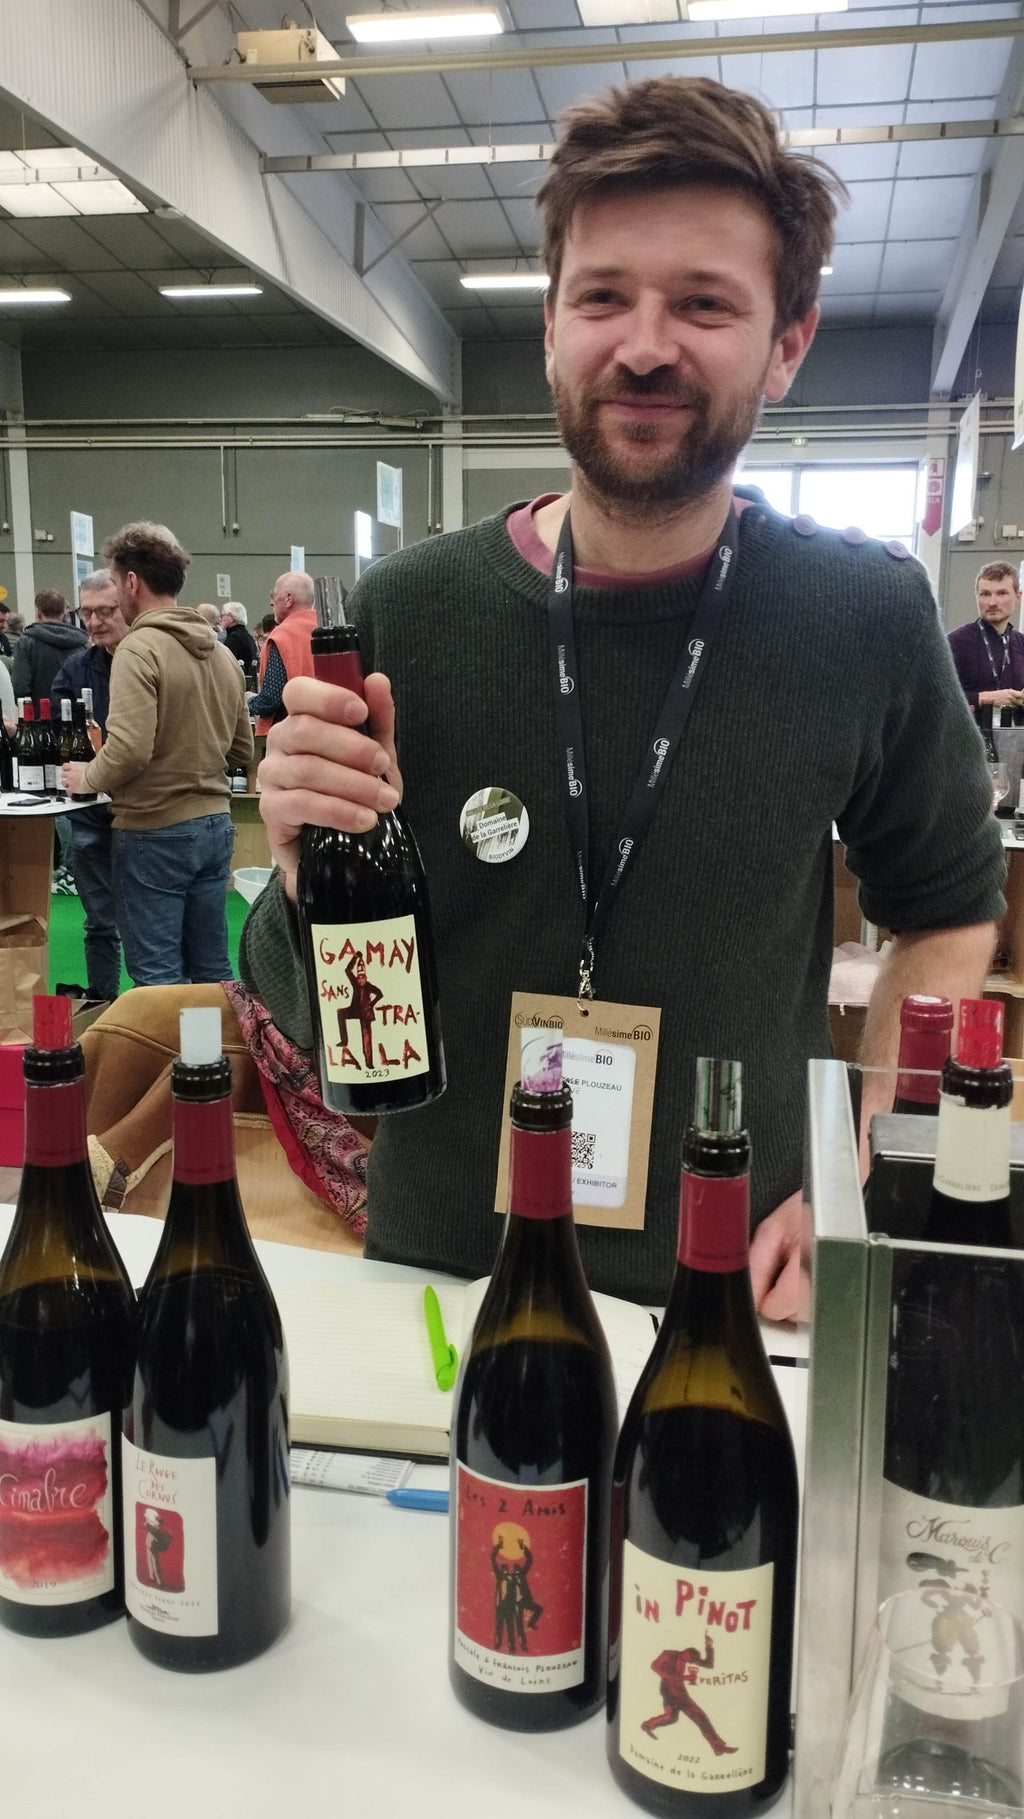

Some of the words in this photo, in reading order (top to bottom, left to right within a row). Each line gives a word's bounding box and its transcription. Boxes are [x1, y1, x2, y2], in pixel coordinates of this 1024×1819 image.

[479, 815, 506, 829] Domaine
[472, 833, 480, 841] de
[319, 936, 415, 974] GAMAY
[320, 979, 350, 1002] SANS
[327, 1045, 362, 1071] LA
[378, 1038, 421, 1070] LA
[364, 1068, 390, 1078] 2023
[581, 1079, 623, 1091] PLOUZEAU
[576, 1177, 618, 1189] EXHIBITOR
[0, 1467, 88, 1513] Cinabre
[498, 1499, 507, 1513] 2
[905, 1515, 992, 1552] Marquis
[677, 1753, 701, 1764] 2022
